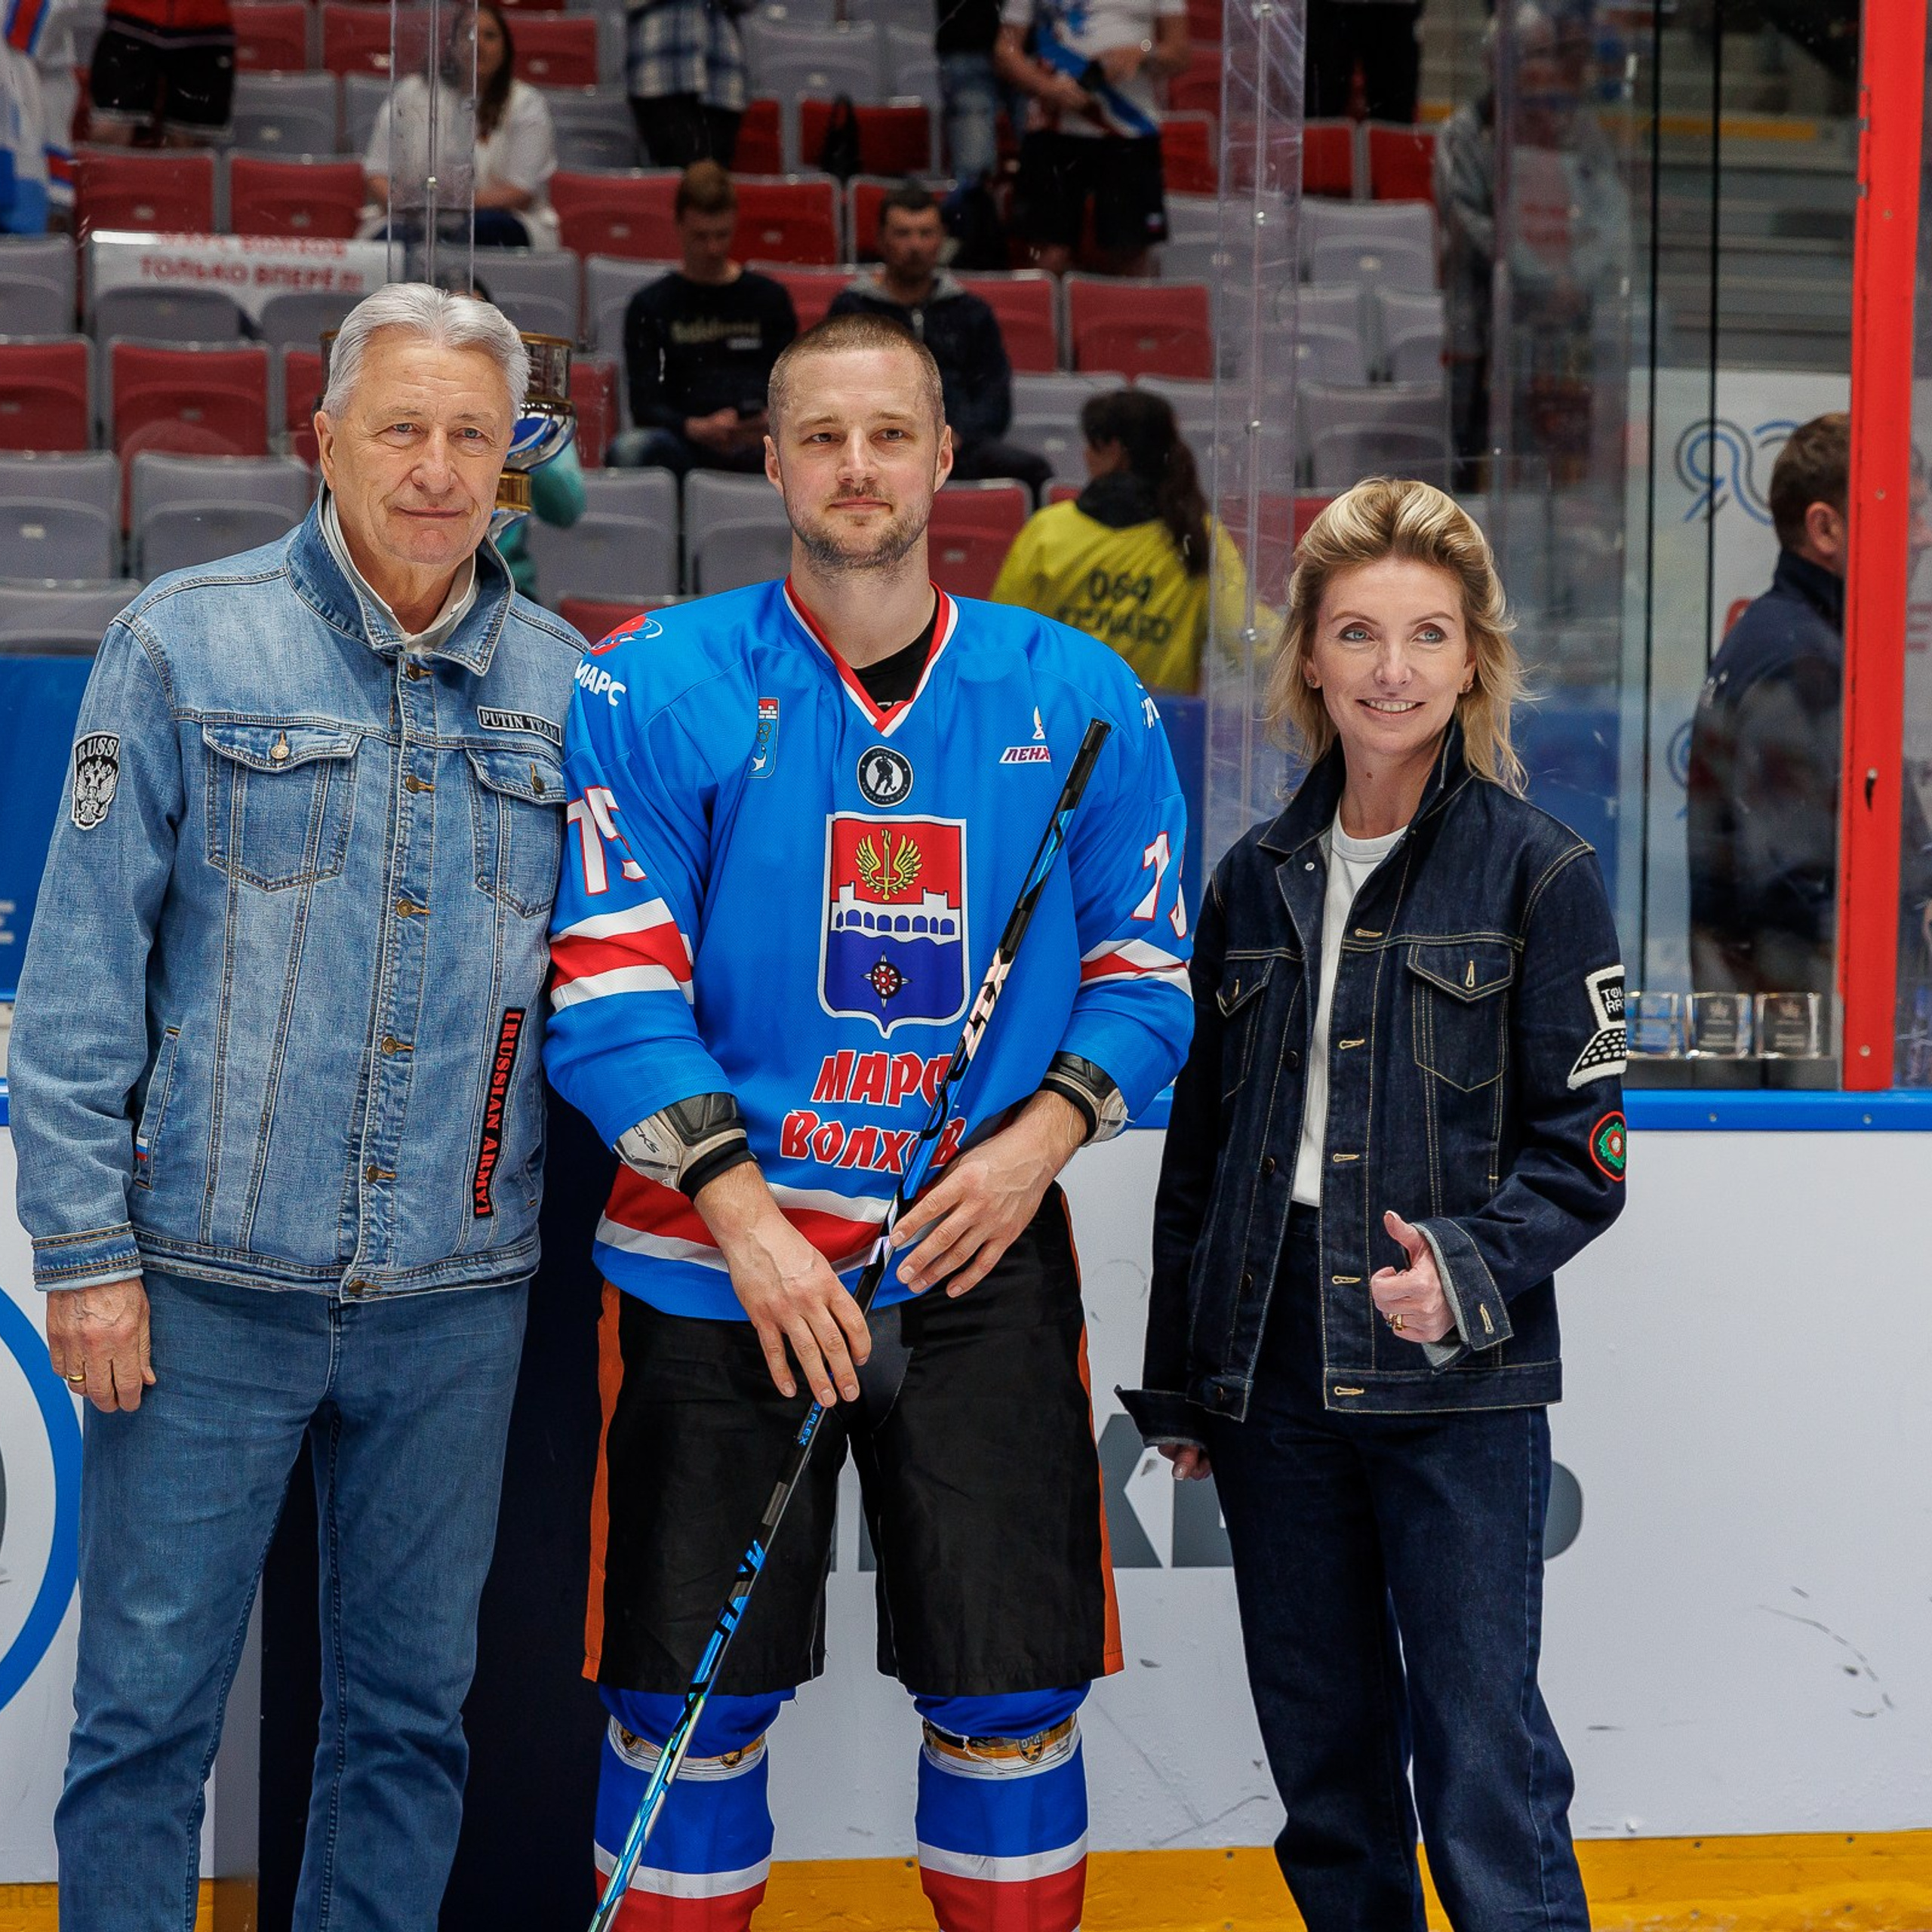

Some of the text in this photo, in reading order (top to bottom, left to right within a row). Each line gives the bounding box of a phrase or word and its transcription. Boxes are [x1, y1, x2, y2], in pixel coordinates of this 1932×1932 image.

[481, 711, 558, 741] PUTIN TEAM
[475, 1011, 522, 1214] [RUSSIAN ARMY]
[798, 1413, 818, 1447] FLEX
